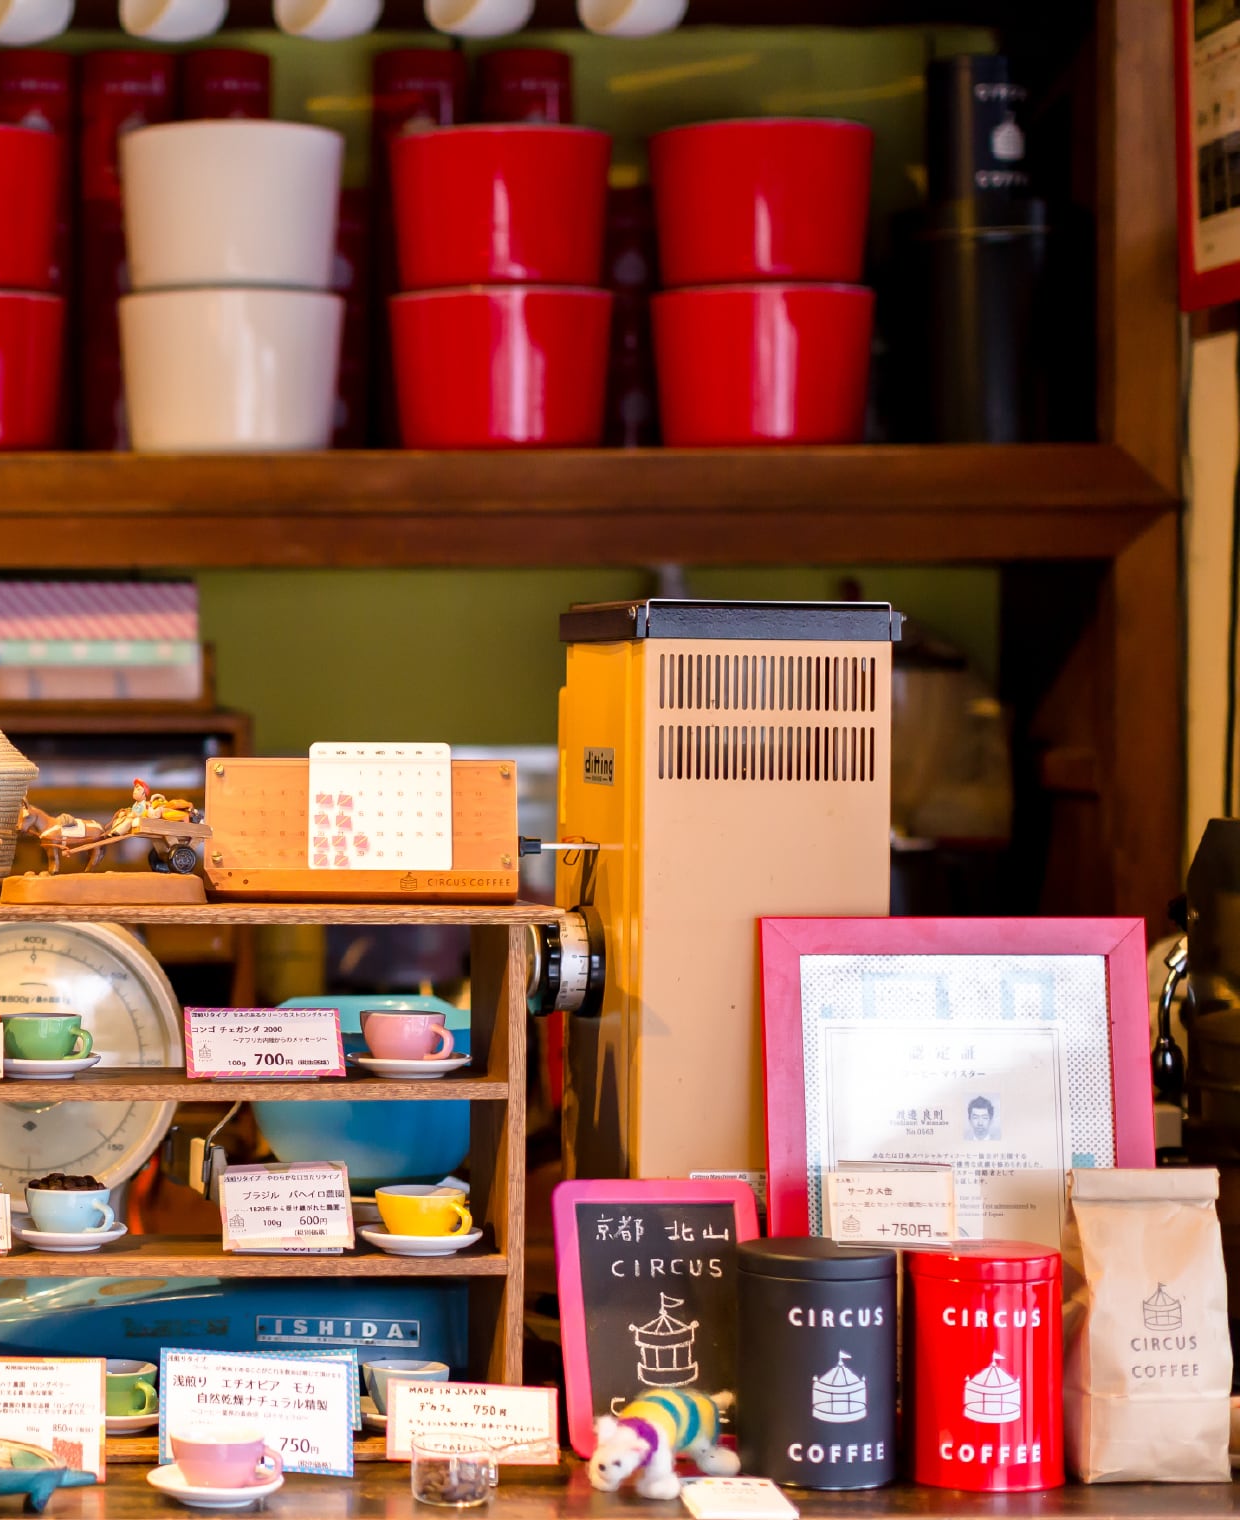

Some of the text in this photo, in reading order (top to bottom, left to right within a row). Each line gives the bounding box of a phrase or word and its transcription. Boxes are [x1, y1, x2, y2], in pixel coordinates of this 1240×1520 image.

[585, 751, 613, 782] ditting
[220, 1025, 260, 1033] チェガンダ
[242, 1191, 280, 1200] ブラジル
[847, 1186, 893, 1196] サーカス缶
[300, 1215, 328, 1226] 600円
[595, 1213, 730, 1243] 京都 北山
[611, 1258, 722, 1278] CIRCUS
[787, 1306, 884, 1328] CIRCUS
[942, 1307, 1041, 1328] CIRCUS
[274, 1317, 404, 1339] ISHIDA
[1130, 1336, 1198, 1352] CIRCUS
[1131, 1363, 1199, 1379] COFFEE
[172, 1374, 316, 1395] 浅煎り エチオピア モカ
[409, 1387, 487, 1396] MADE IN JAPAN
[196, 1392, 329, 1411] 自然乾燥ナチュラル精製
[279, 1437, 320, 1455] 750円
[787, 1442, 884, 1464] COFFEE
[939, 1442, 1041, 1465] COFFEE
